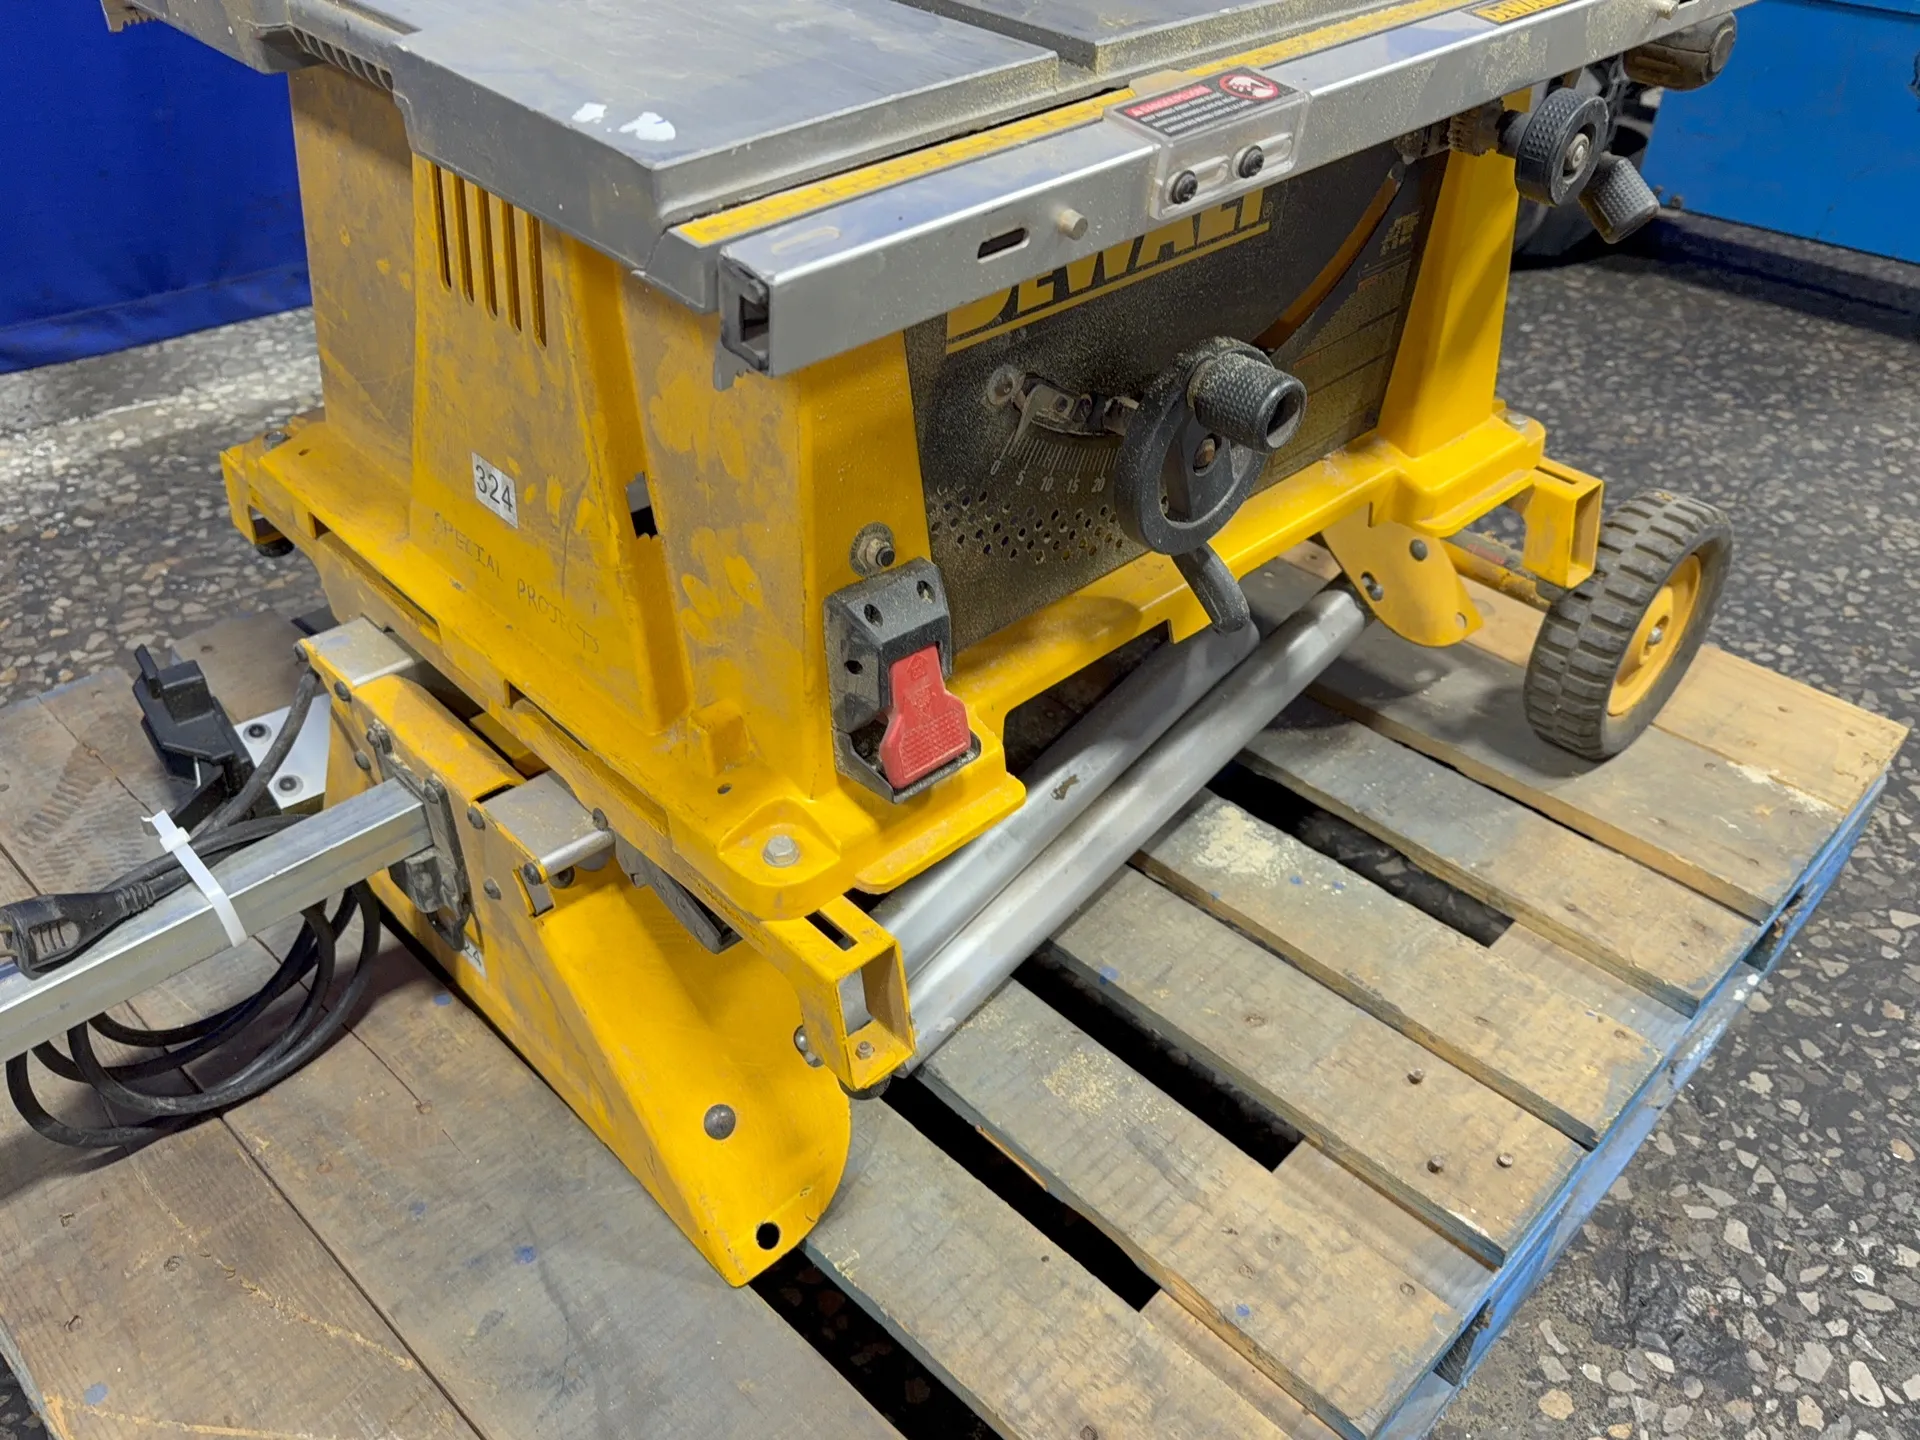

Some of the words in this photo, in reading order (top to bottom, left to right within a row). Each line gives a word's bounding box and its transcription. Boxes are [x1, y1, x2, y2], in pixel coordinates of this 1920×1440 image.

[476, 464, 513, 513] 324
[989, 460, 1001, 475] 0
[1016, 469, 1027, 486] 5
[1040, 476, 1054, 492] 10
[1066, 479, 1080, 494] 15
[1091, 477, 1106, 493] 20
[432, 512, 504, 582] SPECIAL
[517, 578, 599, 654] PROJECTS
[464, 940, 482, 967] 24
